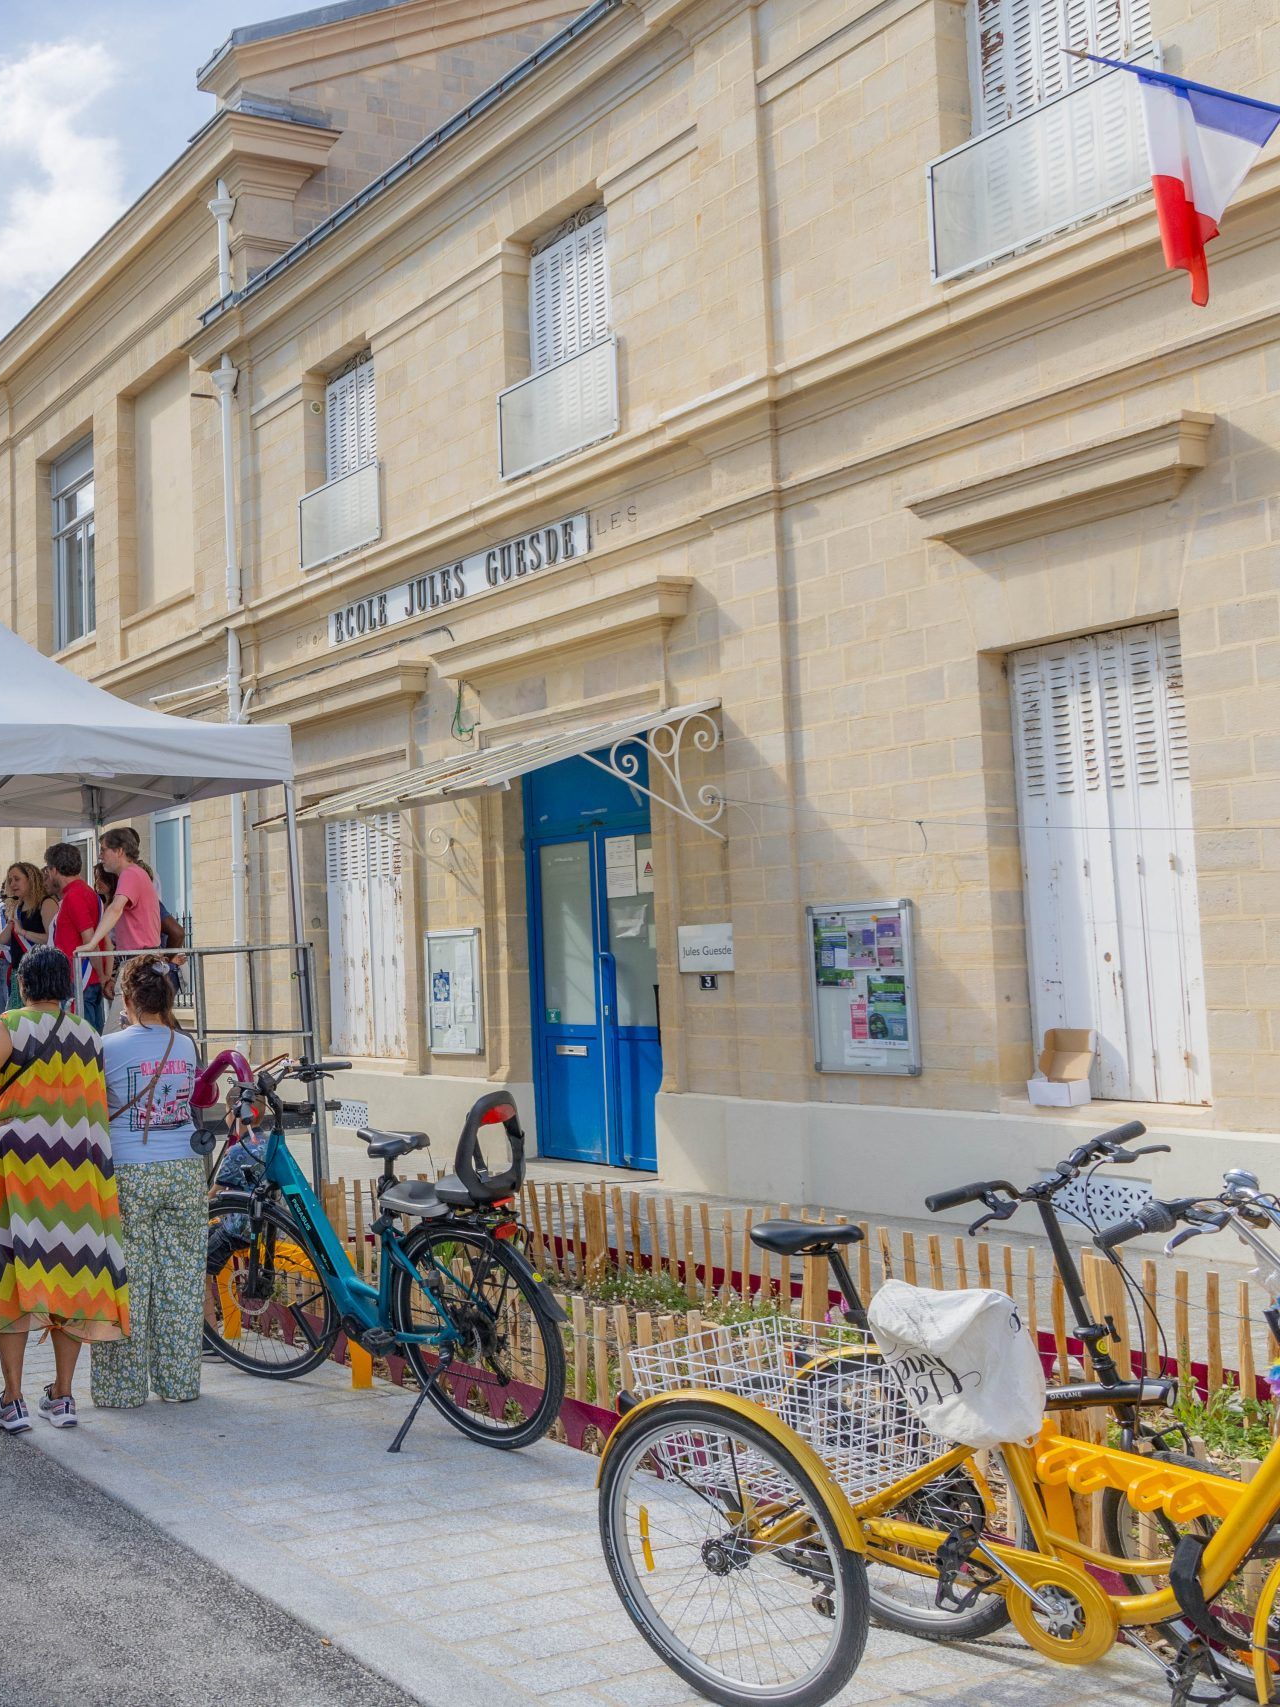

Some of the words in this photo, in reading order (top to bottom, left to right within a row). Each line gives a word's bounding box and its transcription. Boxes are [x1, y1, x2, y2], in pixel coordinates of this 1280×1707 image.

[333, 592, 388, 643] ECOLE
[404, 560, 465, 617] JULES
[485, 521, 575, 588] GUESDE
[682, 946, 700, 958] Jules
[702, 945, 732, 956] Guesde
[704, 976, 712, 988] 3
[291, 1198, 311, 1231] PEGASUS
[909, 1367, 946, 1406] La
[1049, 1391, 1083, 1401] OXYLANE
